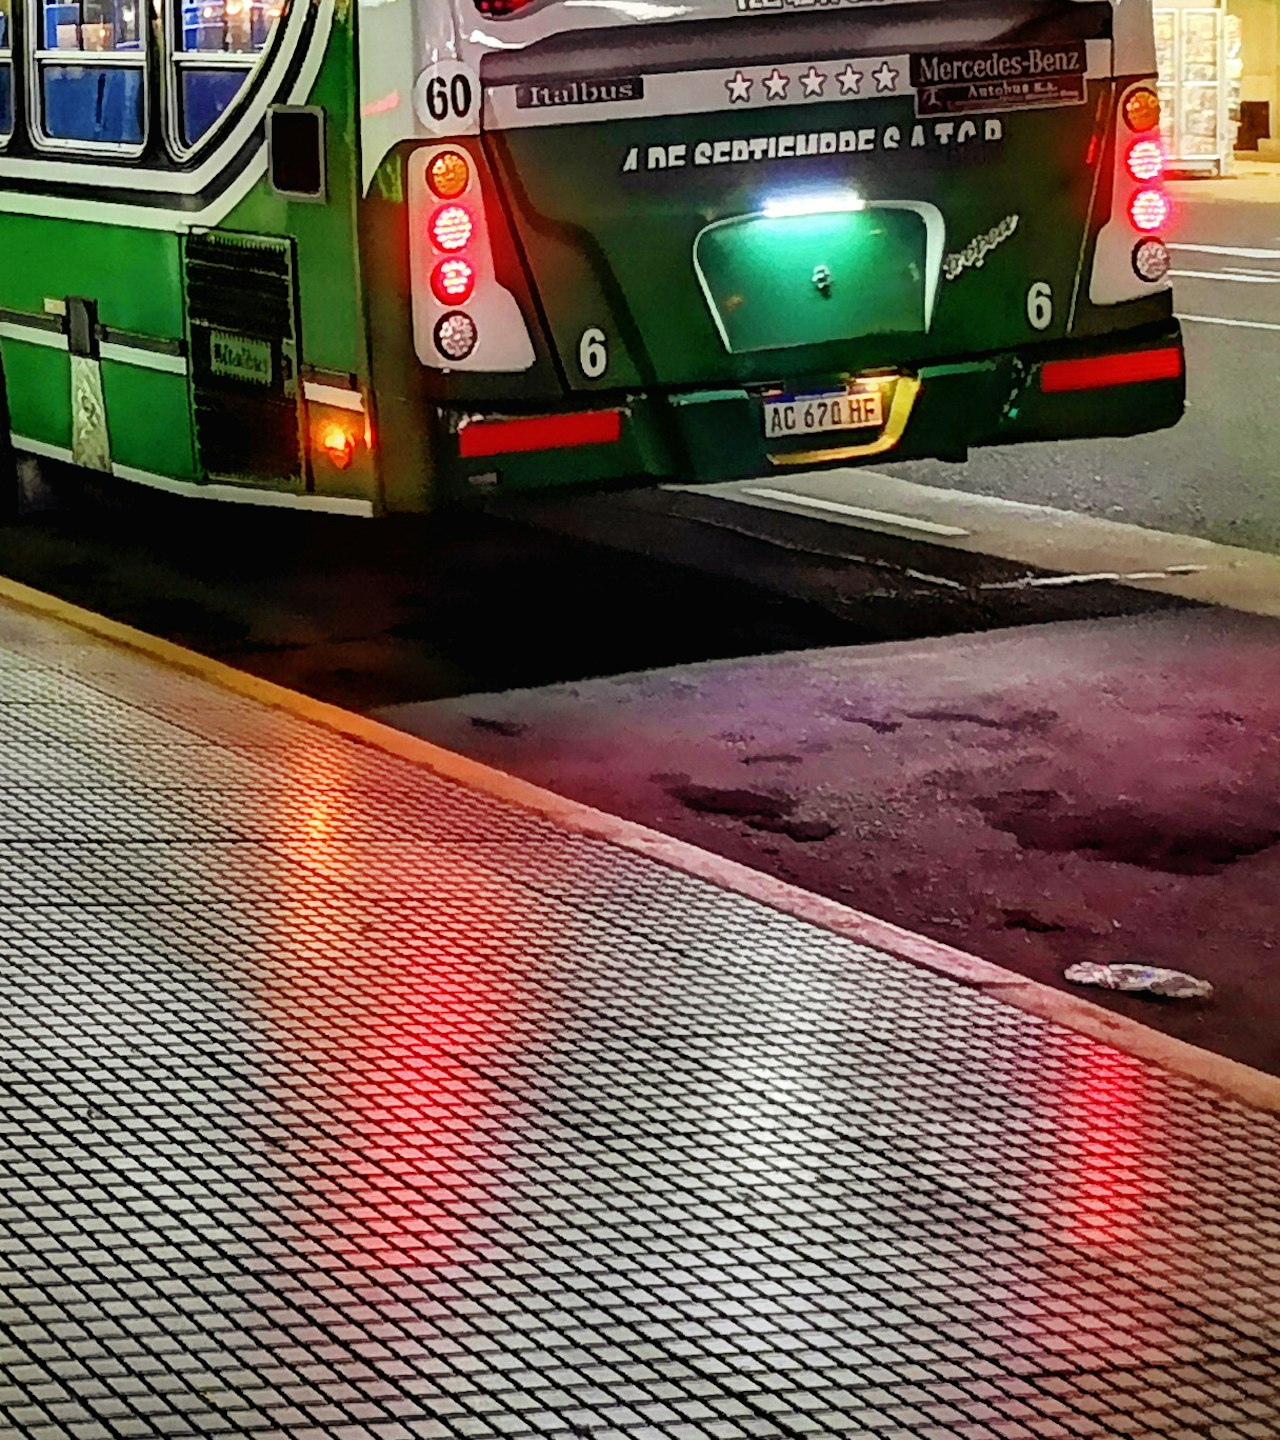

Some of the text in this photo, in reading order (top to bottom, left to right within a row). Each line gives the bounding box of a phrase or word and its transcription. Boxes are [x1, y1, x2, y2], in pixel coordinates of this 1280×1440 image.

[919, 48, 1082, 83] Mercedes-Benz
[426, 73, 473, 122] 60
[529, 81, 634, 106] Italbus
[1025, 281, 1054, 331] 6
[578, 327, 607, 380] 6
[771, 406, 796, 434] AC
[803, 400, 842, 428] 670
